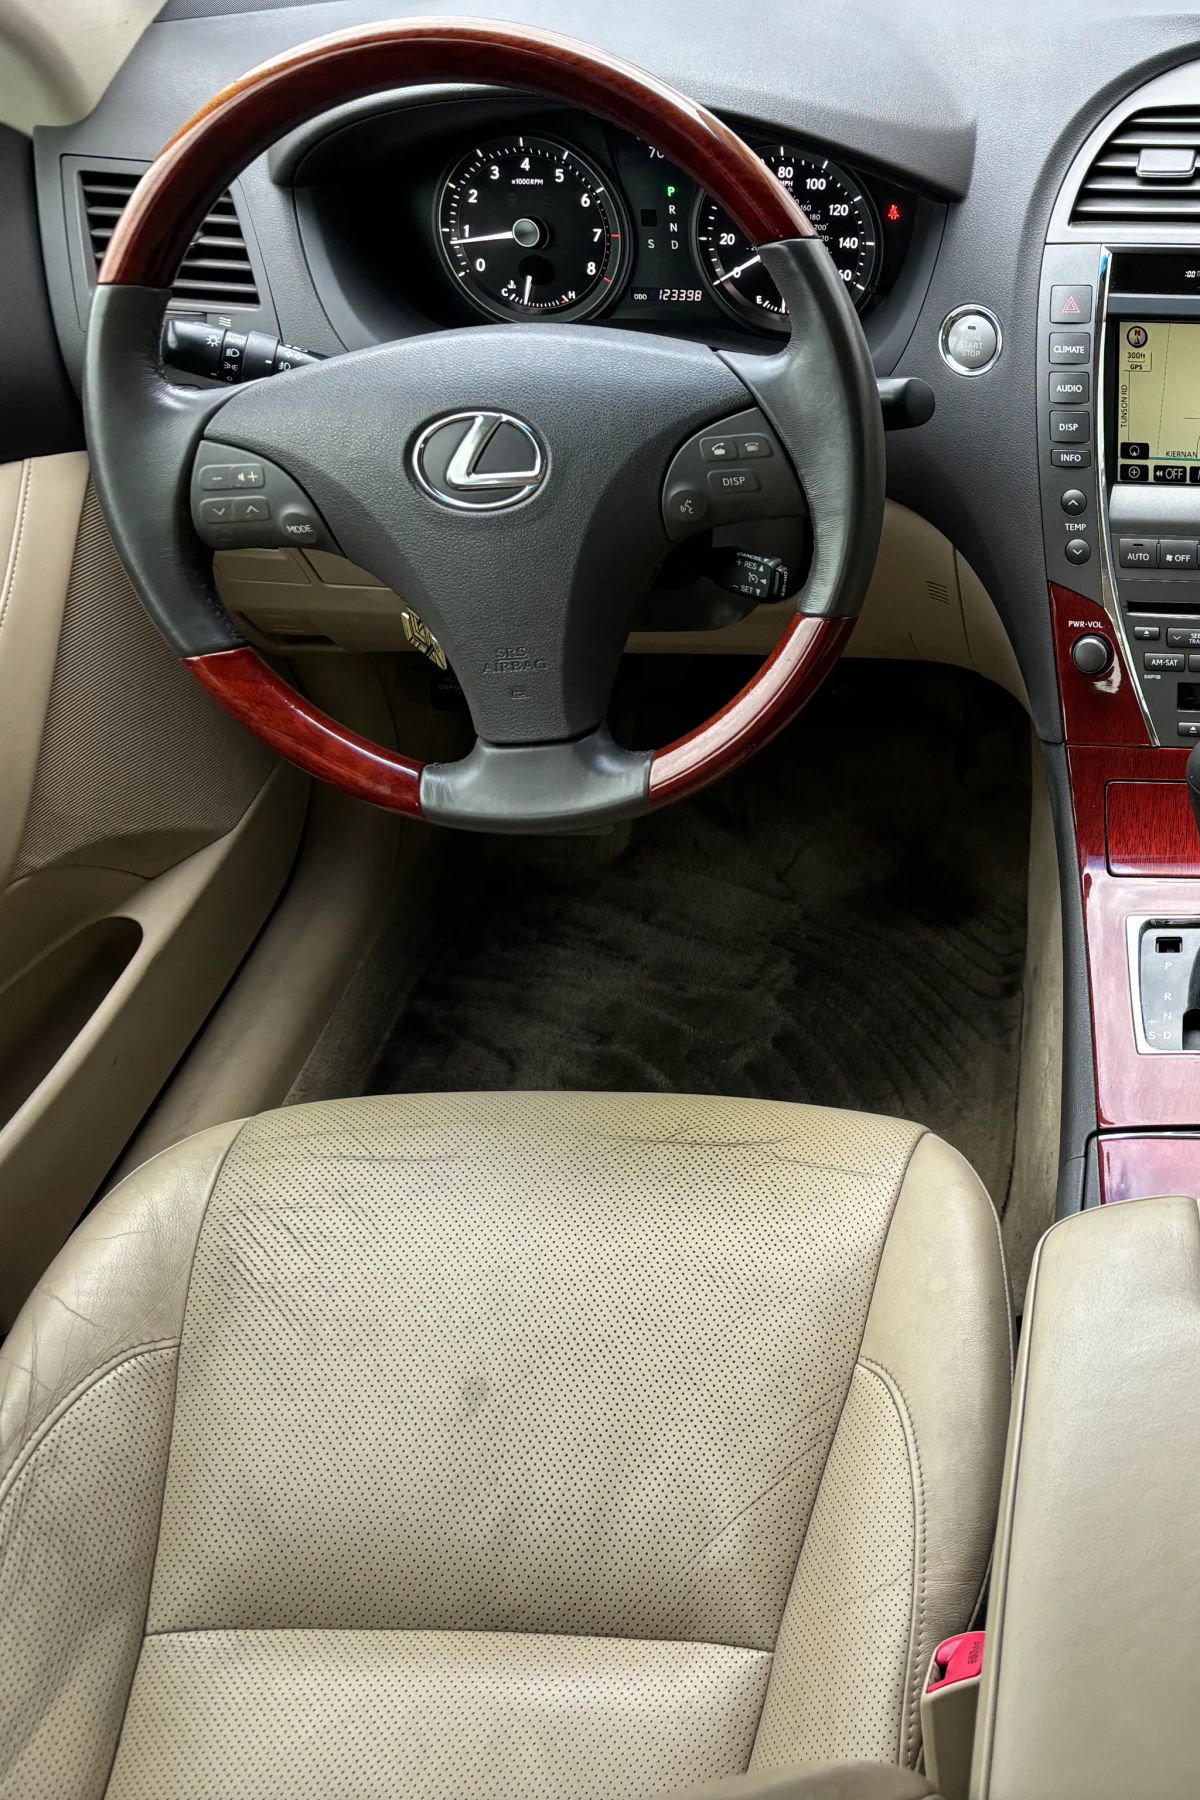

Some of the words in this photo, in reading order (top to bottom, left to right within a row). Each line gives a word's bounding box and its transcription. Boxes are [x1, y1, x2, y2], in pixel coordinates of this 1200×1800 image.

[520, 158, 530, 170] 4
[490, 166, 500, 180] 3
[555, 168, 564, 182] 5
[778, 166, 794, 178] 80
[806, 178, 826, 190] 100
[468, 189, 478, 203] 2
[667, 186, 676, 196] P
[580, 194, 590, 207] 6
[668, 204, 676, 214] R
[828, 204, 848, 216] 120
[464, 224, 470, 238] 1
[670, 222, 678, 232] N
[592, 228, 602, 242] 7
[720, 232, 736, 245] 20
[648, 238, 655, 249] S
[671, 240, 678, 250] D
[838, 237, 858, 249] 140
[476, 258, 486, 272] 0
[586, 262, 596, 276] 8
[501, 288, 508, 296] C
[568, 291, 576, 299] H
[658, 288, 702, 302] 123398
[756, 296, 762, 304] E
[960, 342, 984, 350] START
[1053, 345, 1085, 354] CLIMATE
[1056, 384, 1083, 393] AUDIO
[1121, 384, 1128, 396] RD
[1059, 423, 1079, 431] DISP
[1060, 454, 1082, 462] INFO
[1165, 468, 1184, 480] OFF
[722, 476, 746, 486] DISP
[286, 524, 314, 534] MODE
[1064, 523, 1087, 532] TEMP
[1127, 552, 1150, 561] AUTO
[1174, 554, 1192, 562] OFF
[744, 560, 758, 570] RES
[740, 584, 754, 594] SET
[496, 646, 528, 659] SRS
[483, 660, 549, 674] AIRBAG
[1164, 962, 1173, 970] P
[1164, 992, 1172, 1001] R
[1164, 1012, 1172, 1020] N
